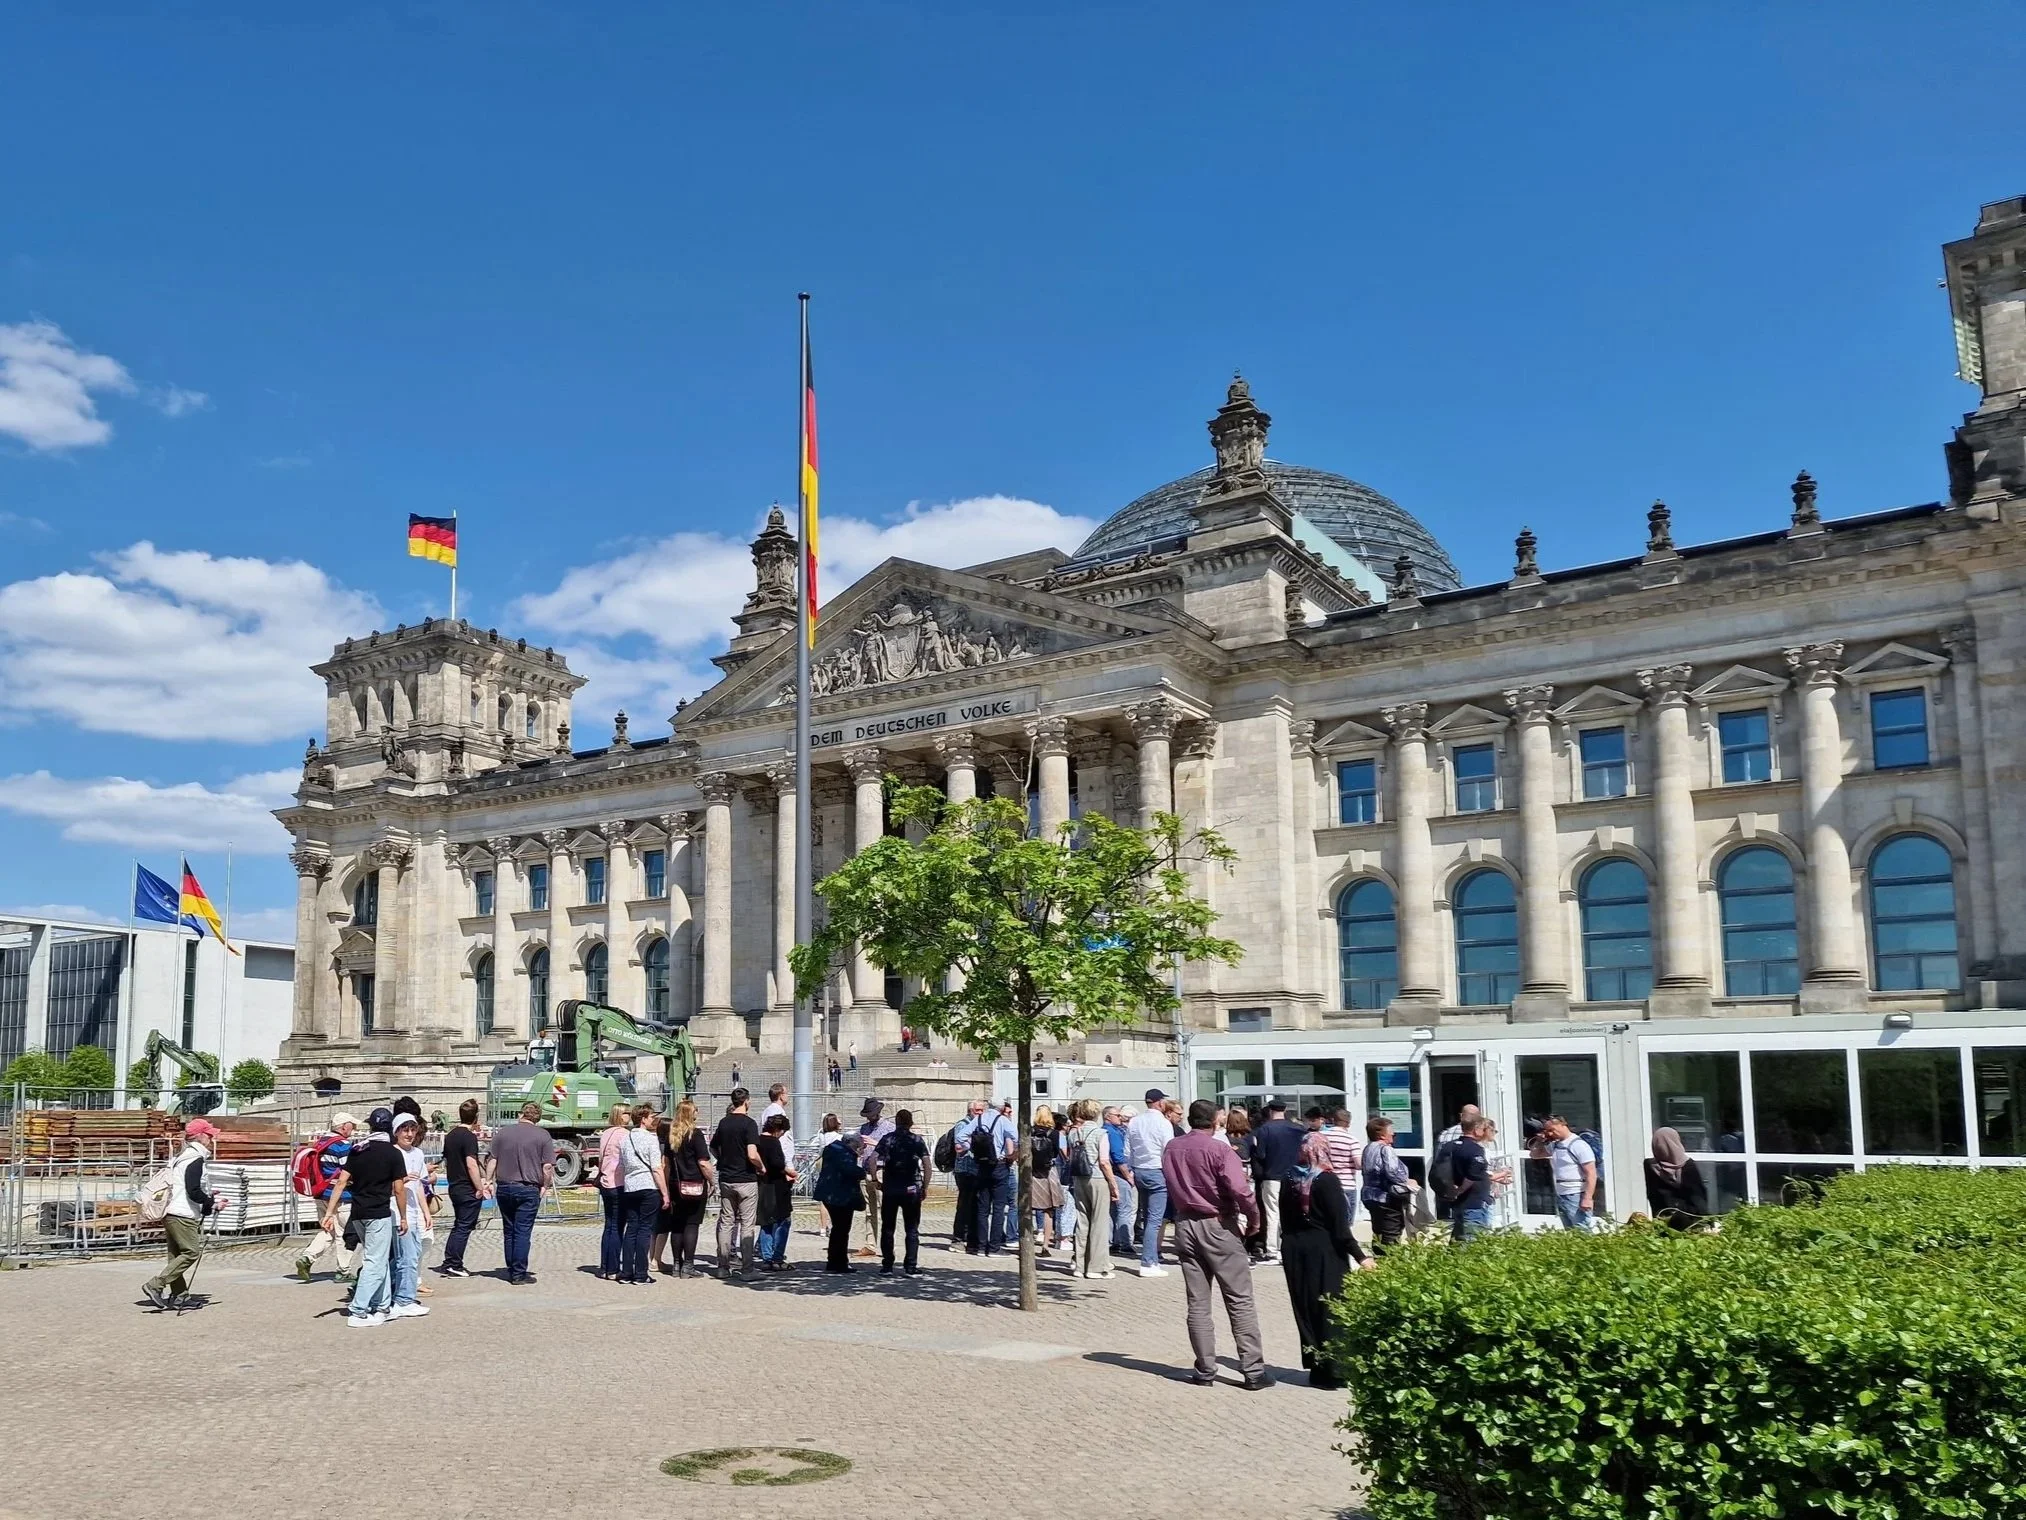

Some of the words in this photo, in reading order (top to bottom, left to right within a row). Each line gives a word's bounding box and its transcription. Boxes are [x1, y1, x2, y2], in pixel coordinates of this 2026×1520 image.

[811, 730, 843, 746] DEM
[856, 711, 946, 739] DEUTSCHEN
[961, 701, 1011, 720] VOLKE
[608, 1026, 622, 1036] OTTO
